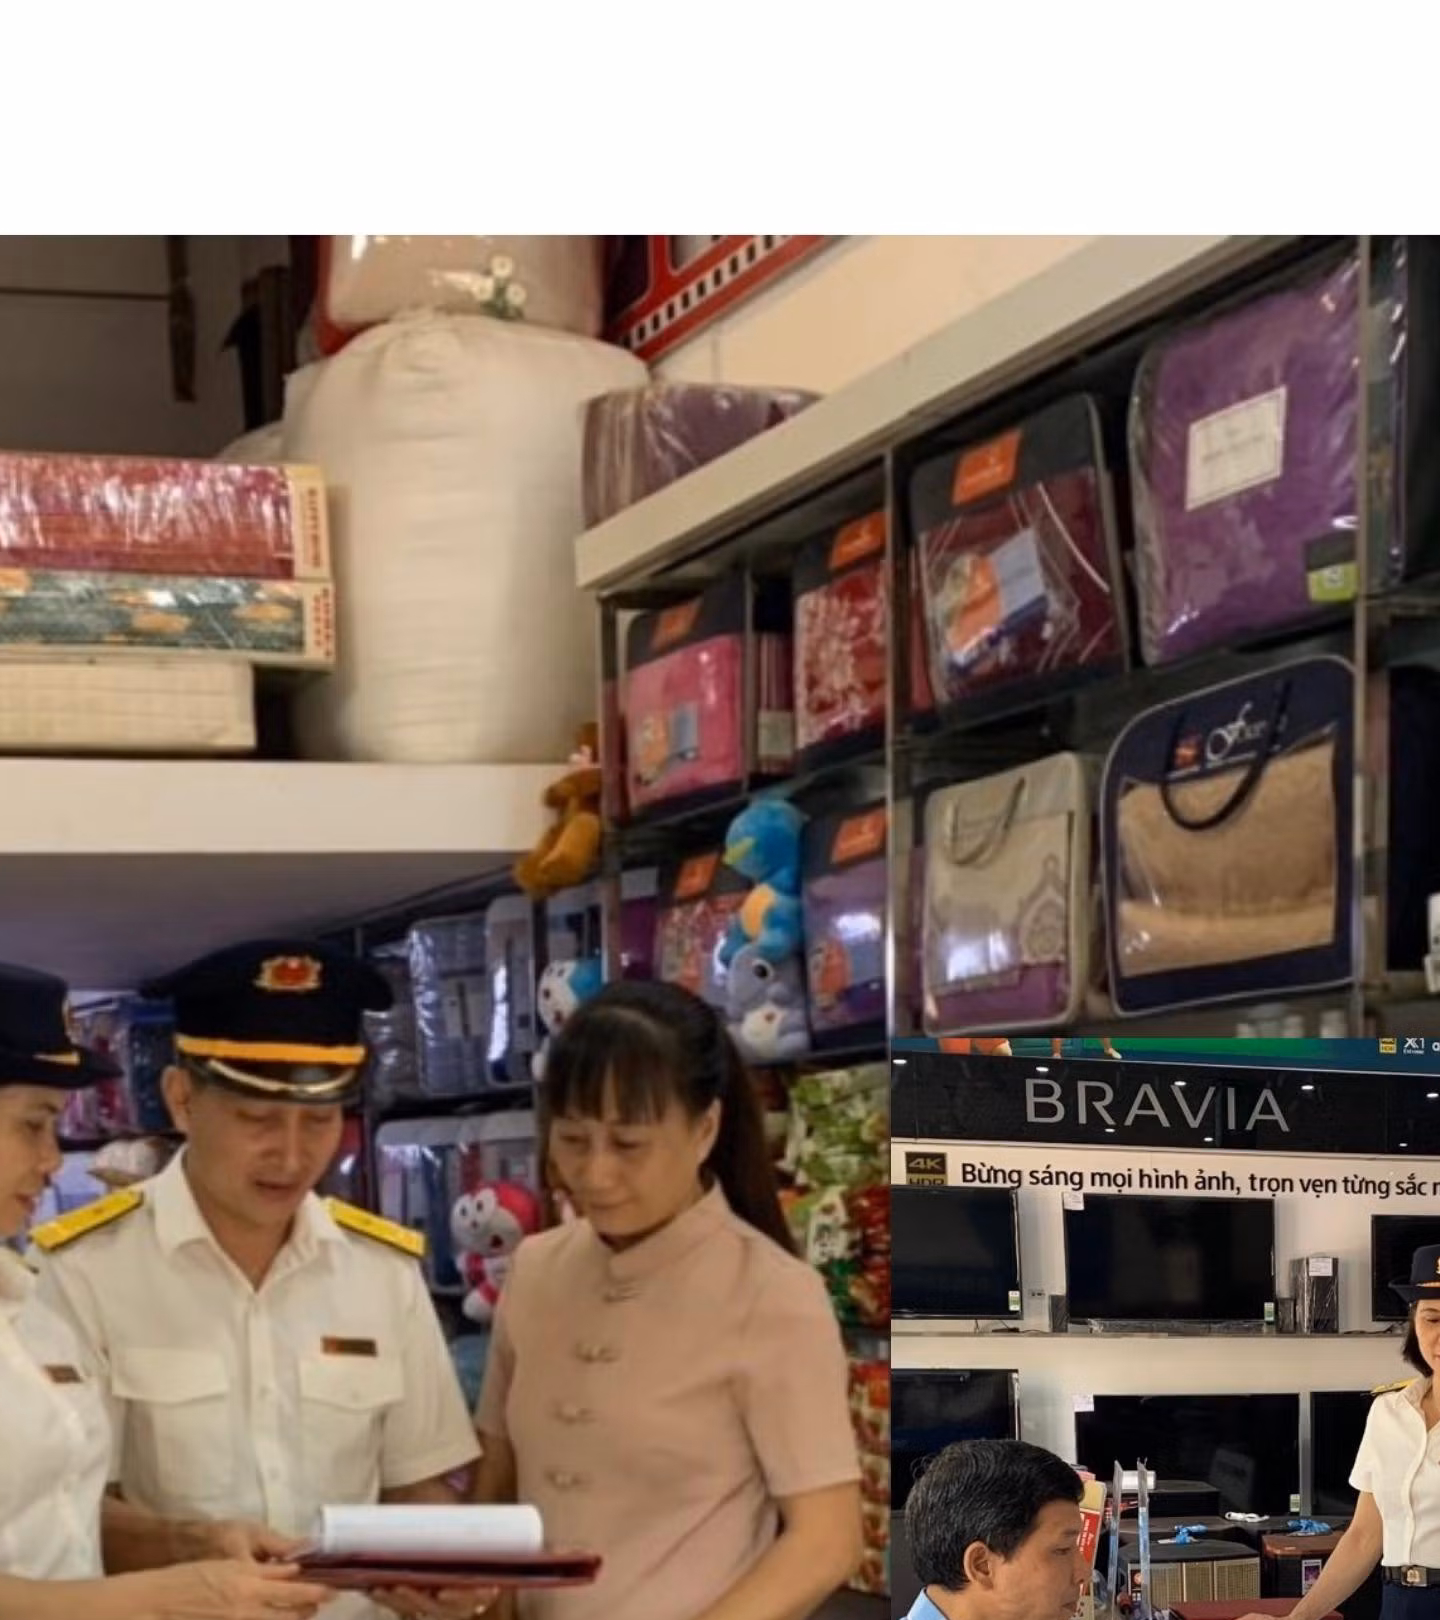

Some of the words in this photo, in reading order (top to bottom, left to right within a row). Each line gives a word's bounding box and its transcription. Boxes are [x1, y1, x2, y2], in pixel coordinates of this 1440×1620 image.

[1024, 1077, 1291, 1133] BRAVIA
[961, 1162, 1023, 1188] Bừng
[1029, 1163, 1085, 1190] sáng
[1090, 1169, 1133, 1193] mọi
[1139, 1166, 1188, 1189] hình
[1249, 1174, 1294, 1198] trọn
[1298, 1177, 1338, 1198] vẹn
[1343, 1172, 1390, 1199] từng
[1395, 1170, 1428, 1197] sắc
